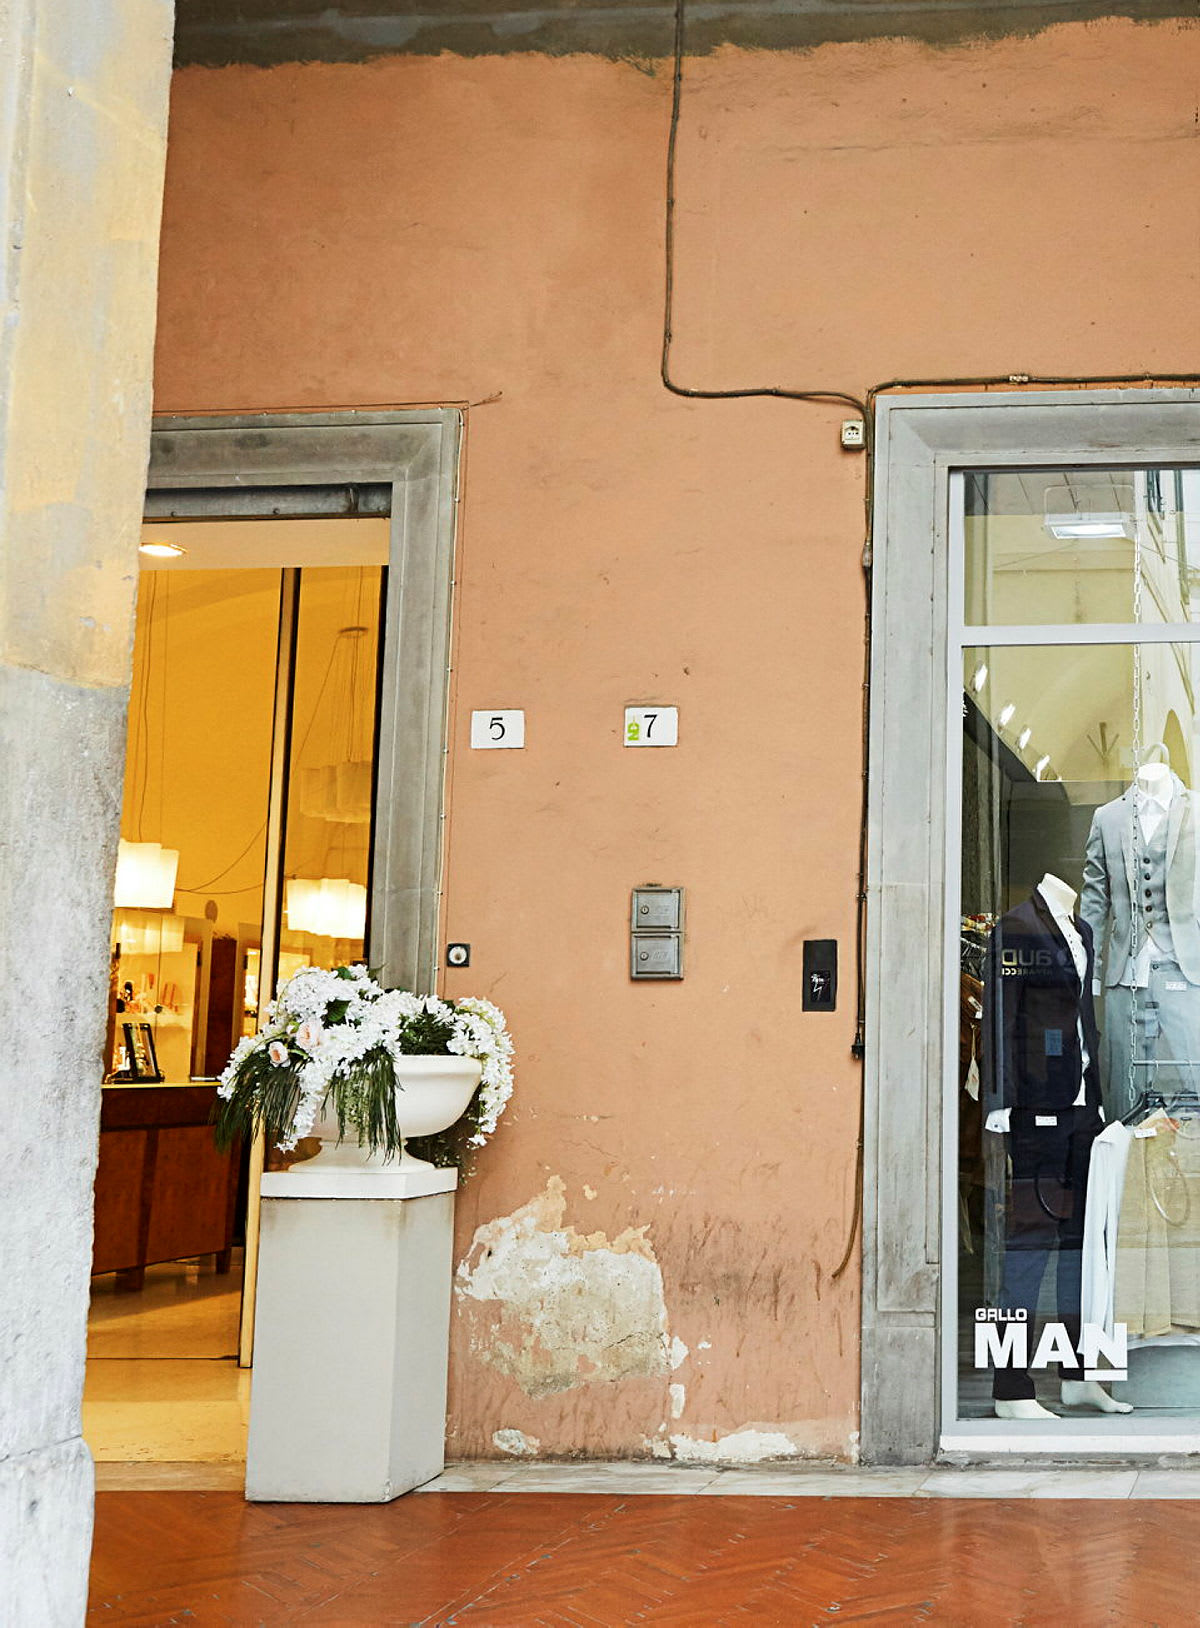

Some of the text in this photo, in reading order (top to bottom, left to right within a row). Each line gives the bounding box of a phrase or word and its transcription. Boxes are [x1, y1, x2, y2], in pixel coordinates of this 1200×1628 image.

[489, 717, 505, 740] 5
[644, 714, 657, 738] 7
[975, 1308, 1027, 1321] GALLO
[974, 1323, 1128, 1369] MAN
